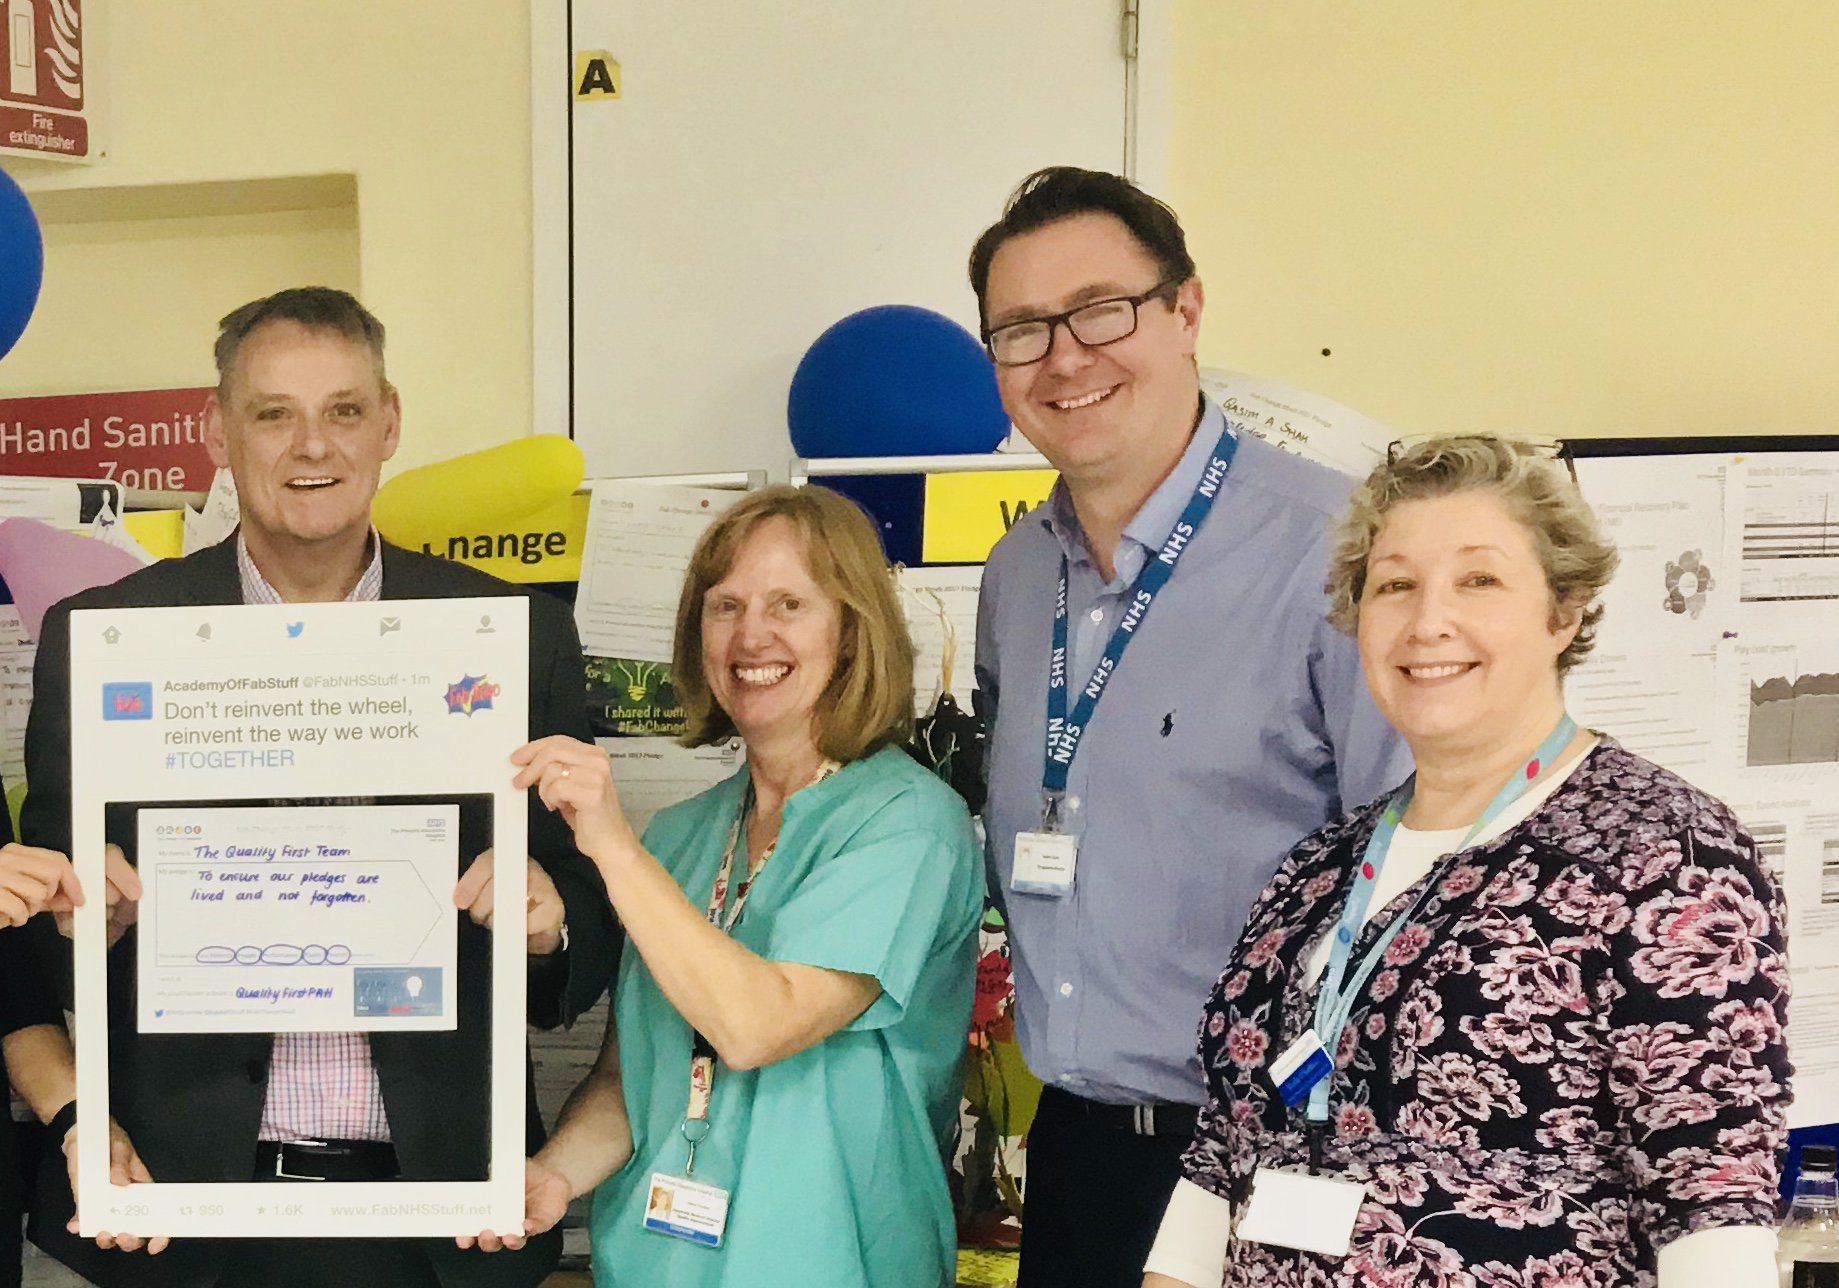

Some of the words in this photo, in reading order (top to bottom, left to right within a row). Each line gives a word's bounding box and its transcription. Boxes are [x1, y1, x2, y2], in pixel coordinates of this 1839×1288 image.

[578, 59, 616, 96] A
[32, 113, 54, 130] Fire
[10, 130, 76, 151] extinguisher
[1265, 417, 1275, 427] A
[0, 419, 91, 455] Hand
[98, 461, 186, 491] Zone
[1199, 456, 1228, 498] NHS
[1158, 522, 1193, 565] NHS
[1122, 589, 1152, 633] NHS
[1050, 647, 1065, 689] NHS
[1085, 656, 1115, 699] NHS
[163, 677, 299, 693] AcademyOfFabStuff
[302, 674, 399, 689] @FabNHSStuff
[410, 673, 431, 686] 1m
[163, 701, 218, 721] Don't
[224, 699, 304, 718] reinvent
[310, 699, 342, 717] the
[349, 696, 414, 717] wheel,
[612, 705, 651, 719] shared
[164, 726, 243, 745] reinvent
[250, 725, 281, 743] the
[287, 726, 328, 746] way
[334, 725, 363, 741] we
[370, 721, 420, 740] work
[1048, 717, 1064, 758] NH
[1053, 722, 1081, 765] NHS
[165, 749, 296, 770] #TOGETHER
[194, 845, 220, 860] The
[225, 847, 276, 863] Quality
[282, 846, 311, 858] First
[316, 845, 351, 858] Team
[198, 870, 213, 882] To
[220, 872, 260, 883] ensure
[270, 872, 294, 883] our
[300, 871, 346, 891] pledges
[357, 874, 380, 884] are
[190, 889, 224, 901] lived
[236, 889, 263, 901] and
[278, 890, 300, 901] not
[124, 1205, 150, 1217] 290
[198, 1205, 225, 1216] 950
[273, 1204, 305, 1216] 1.6K
[331, 1203, 492, 1217] www.FabNHSStuff.net
